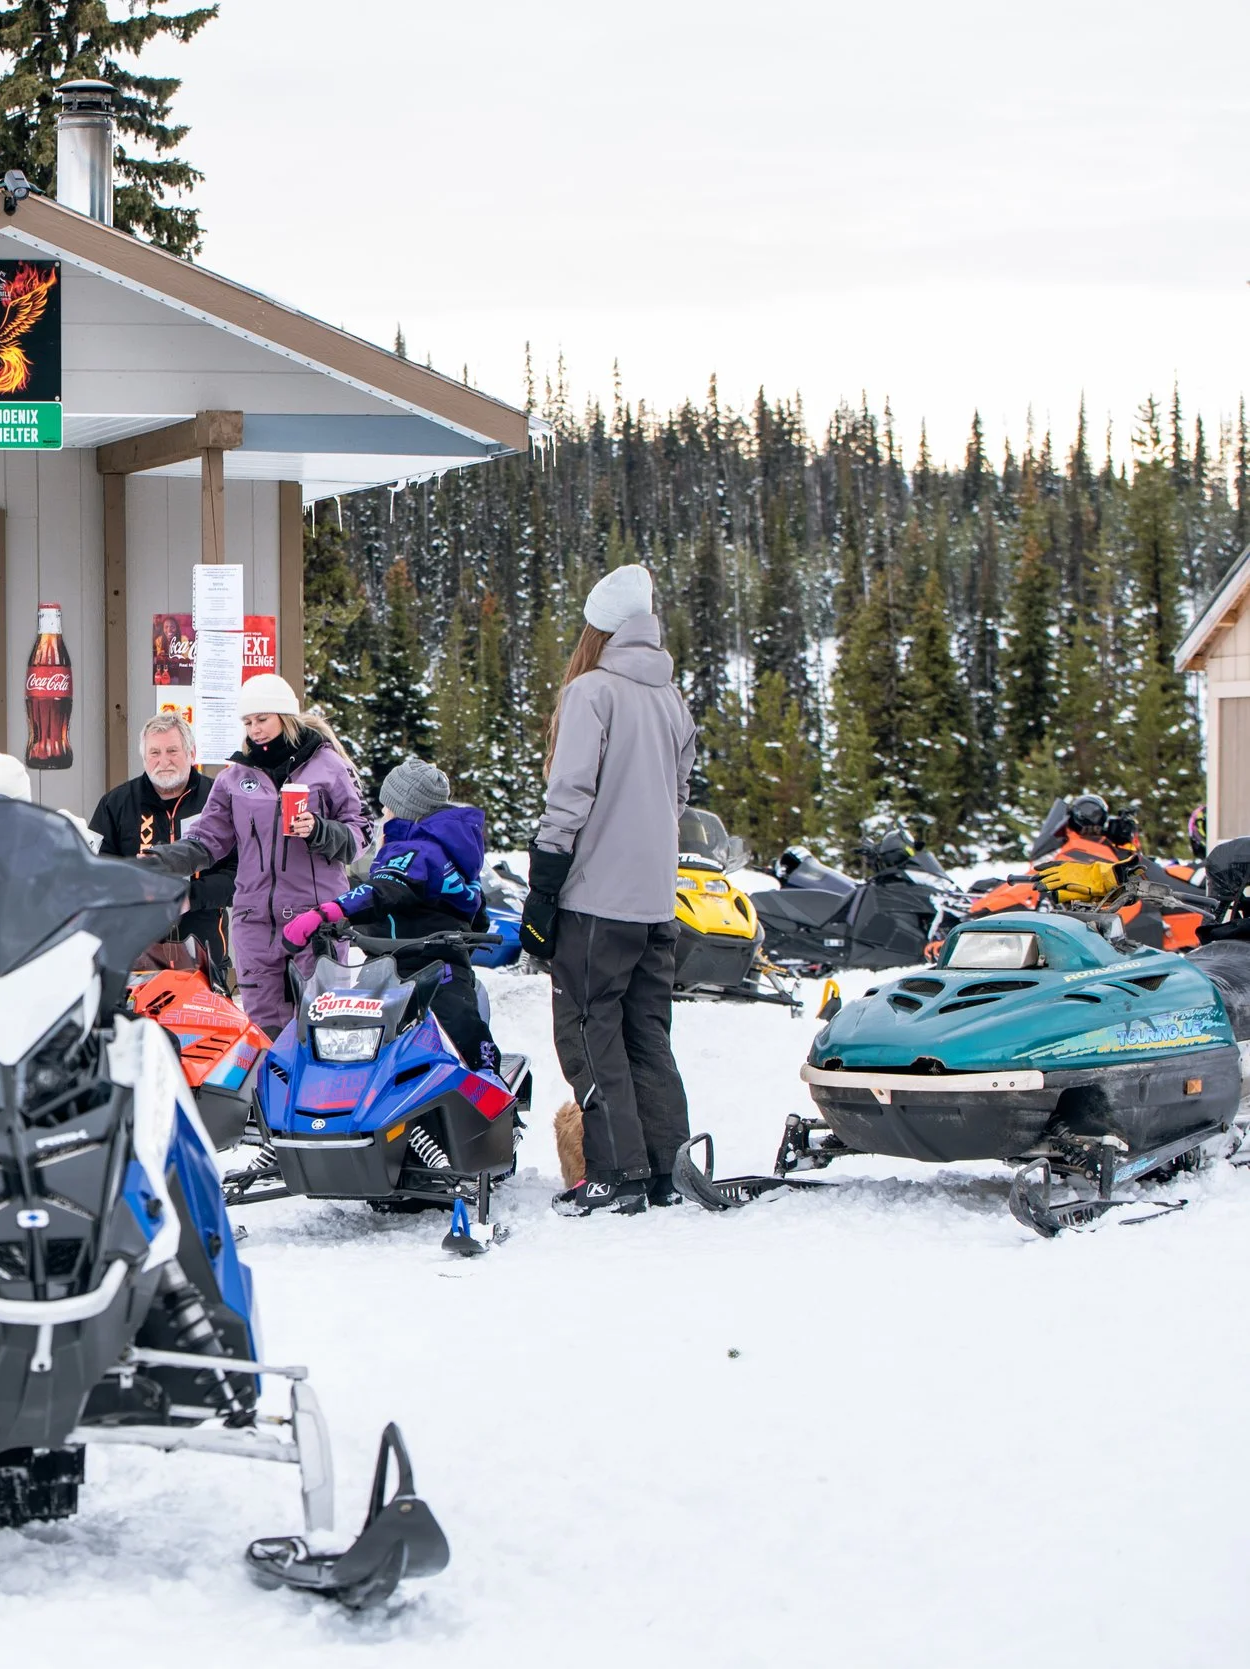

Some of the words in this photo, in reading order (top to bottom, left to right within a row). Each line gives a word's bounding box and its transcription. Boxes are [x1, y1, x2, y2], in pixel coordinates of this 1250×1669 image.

[244, 637, 270, 655] EXT
[26, 673, 70, 691] Coca-Cola
[317, 998, 381, 1011] OUTLAW
[1116, 1023, 1179, 1046] TOURING
[1182, 1020, 1203, 1038] LE
